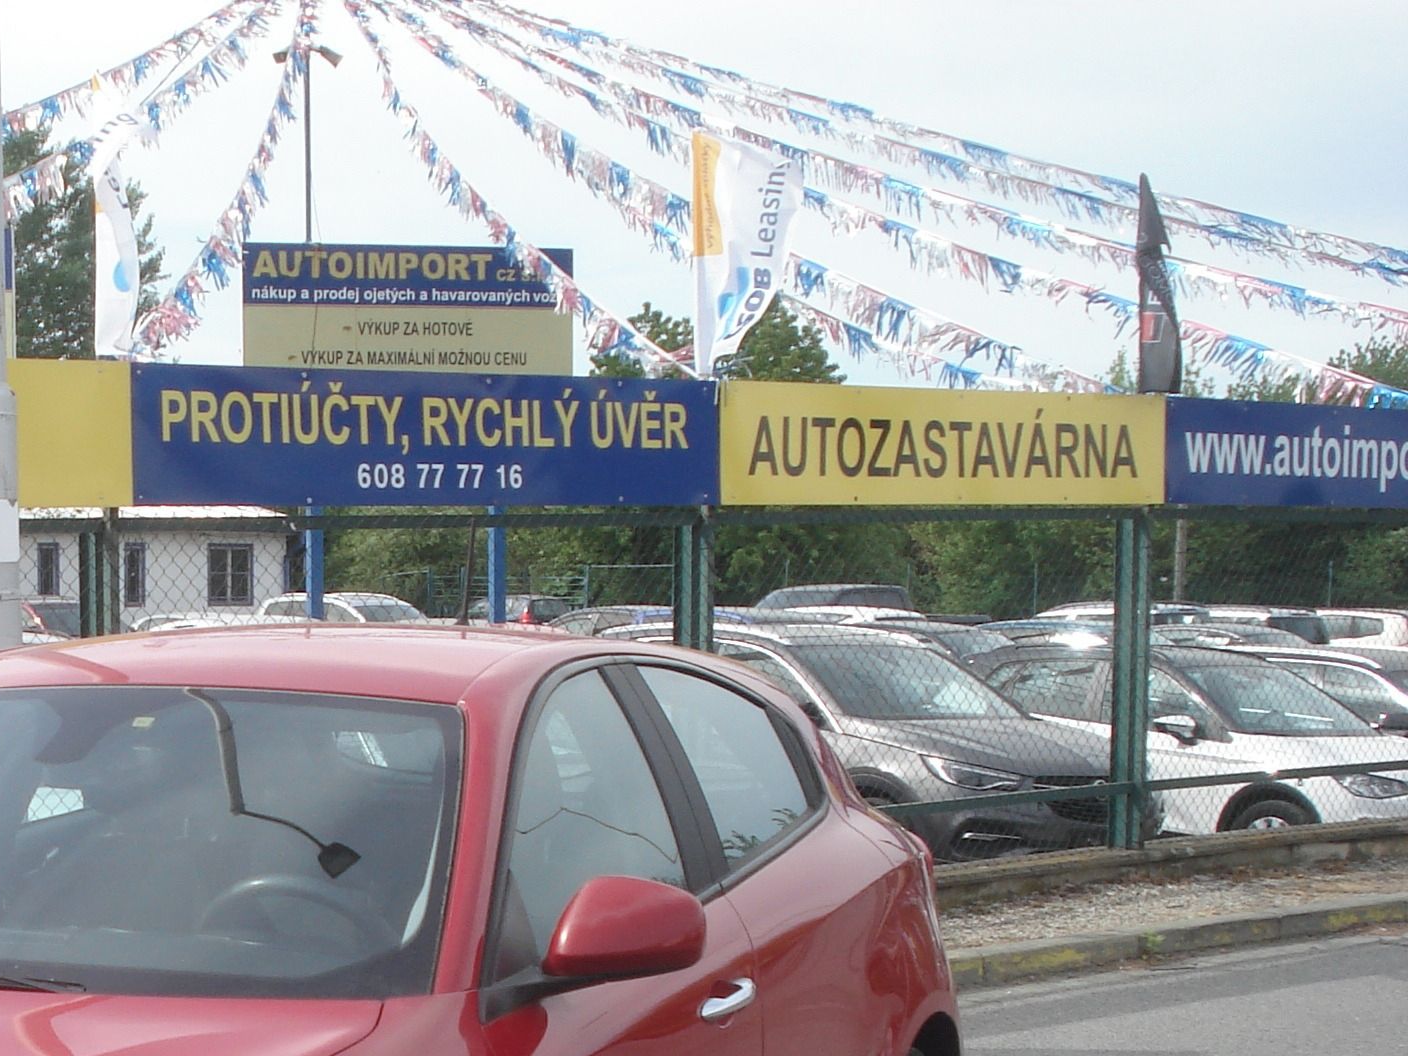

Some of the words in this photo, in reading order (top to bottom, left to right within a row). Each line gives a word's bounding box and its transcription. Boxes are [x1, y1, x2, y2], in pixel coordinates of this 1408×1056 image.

[252, 250, 492, 282] AUTOIMPORT
[496, 269, 516, 282] cz
[251, 285, 297, 302] nákup
[300, 288, 310, 300] a
[313, 286, 360, 303] prodej
[363, 286, 415, 303] ojetých
[419, 289, 428, 301] a
[431, 287, 530, 305] havarovaných
[532, 291, 558, 304] voz
[357, 319, 400, 336] VÝKUP
[403, 321, 419, 336] ZA
[423, 318, 473, 337] HOTOVÉ
[301, 348, 343, 365] VÝKUP
[346, 350, 364, 365] ZA
[367, 347, 435, 366] MAXIMÁLNÍ
[438, 347, 491, 366] MOŽNOU
[494, 350, 528, 366] CENU
[159, 380, 410, 456] PROTIÚČTY,
[422, 387, 579, 448] RYCHLÝ
[590, 387, 690, 450] ÚVĚR
[748, 408, 1139, 479] AUTOZASTAVÁRNA
[356, 462, 406, 490] 608
[416, 462, 445, 490] 77
[456, 463, 485, 490] 77
[496, 463, 523, 490] 16
